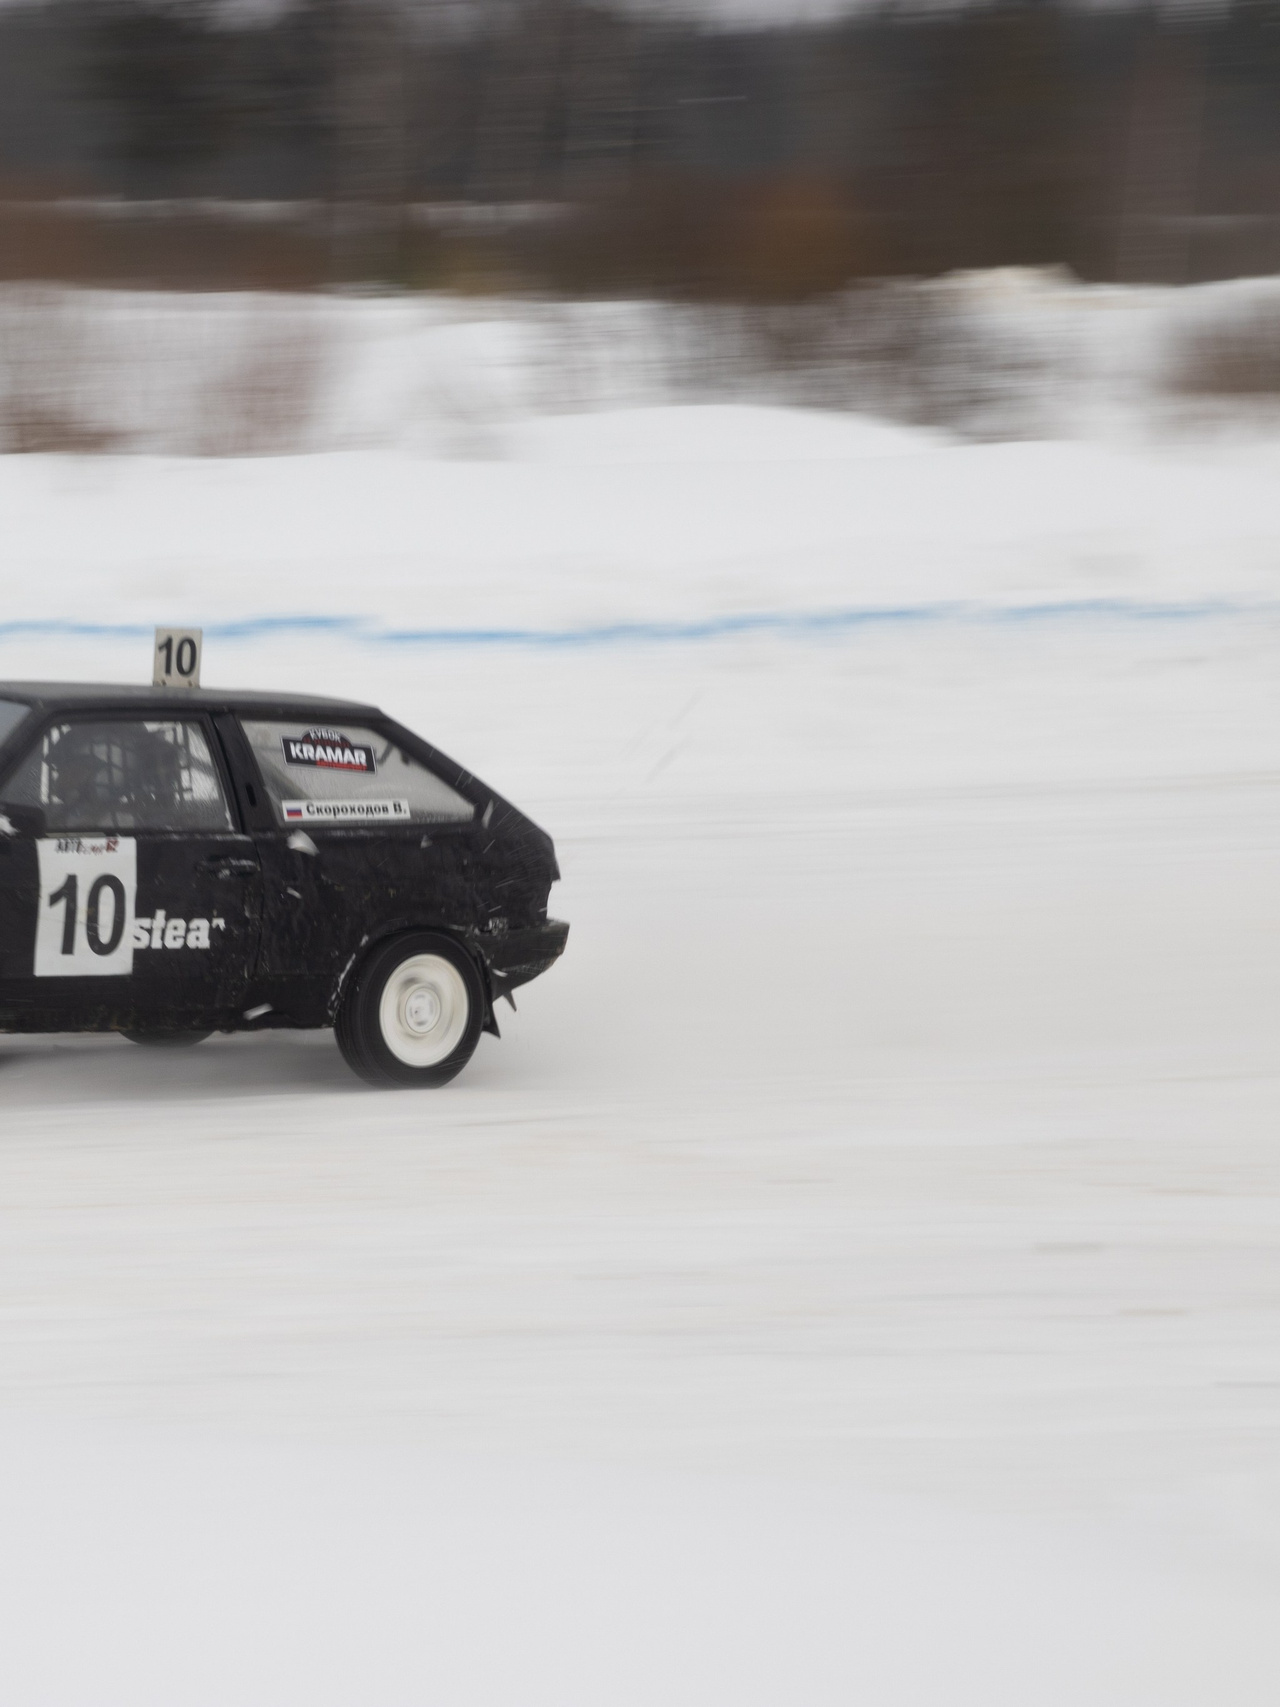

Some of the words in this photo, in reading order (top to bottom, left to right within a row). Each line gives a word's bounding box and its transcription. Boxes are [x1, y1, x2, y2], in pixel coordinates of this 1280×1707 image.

[158, 635, 197, 677] 10
[289, 741, 367, 767] KRAMAR
[306, 801, 389, 818] Скороходов
[393, 801, 407, 814] В.
[48, 873, 126, 956] 10
